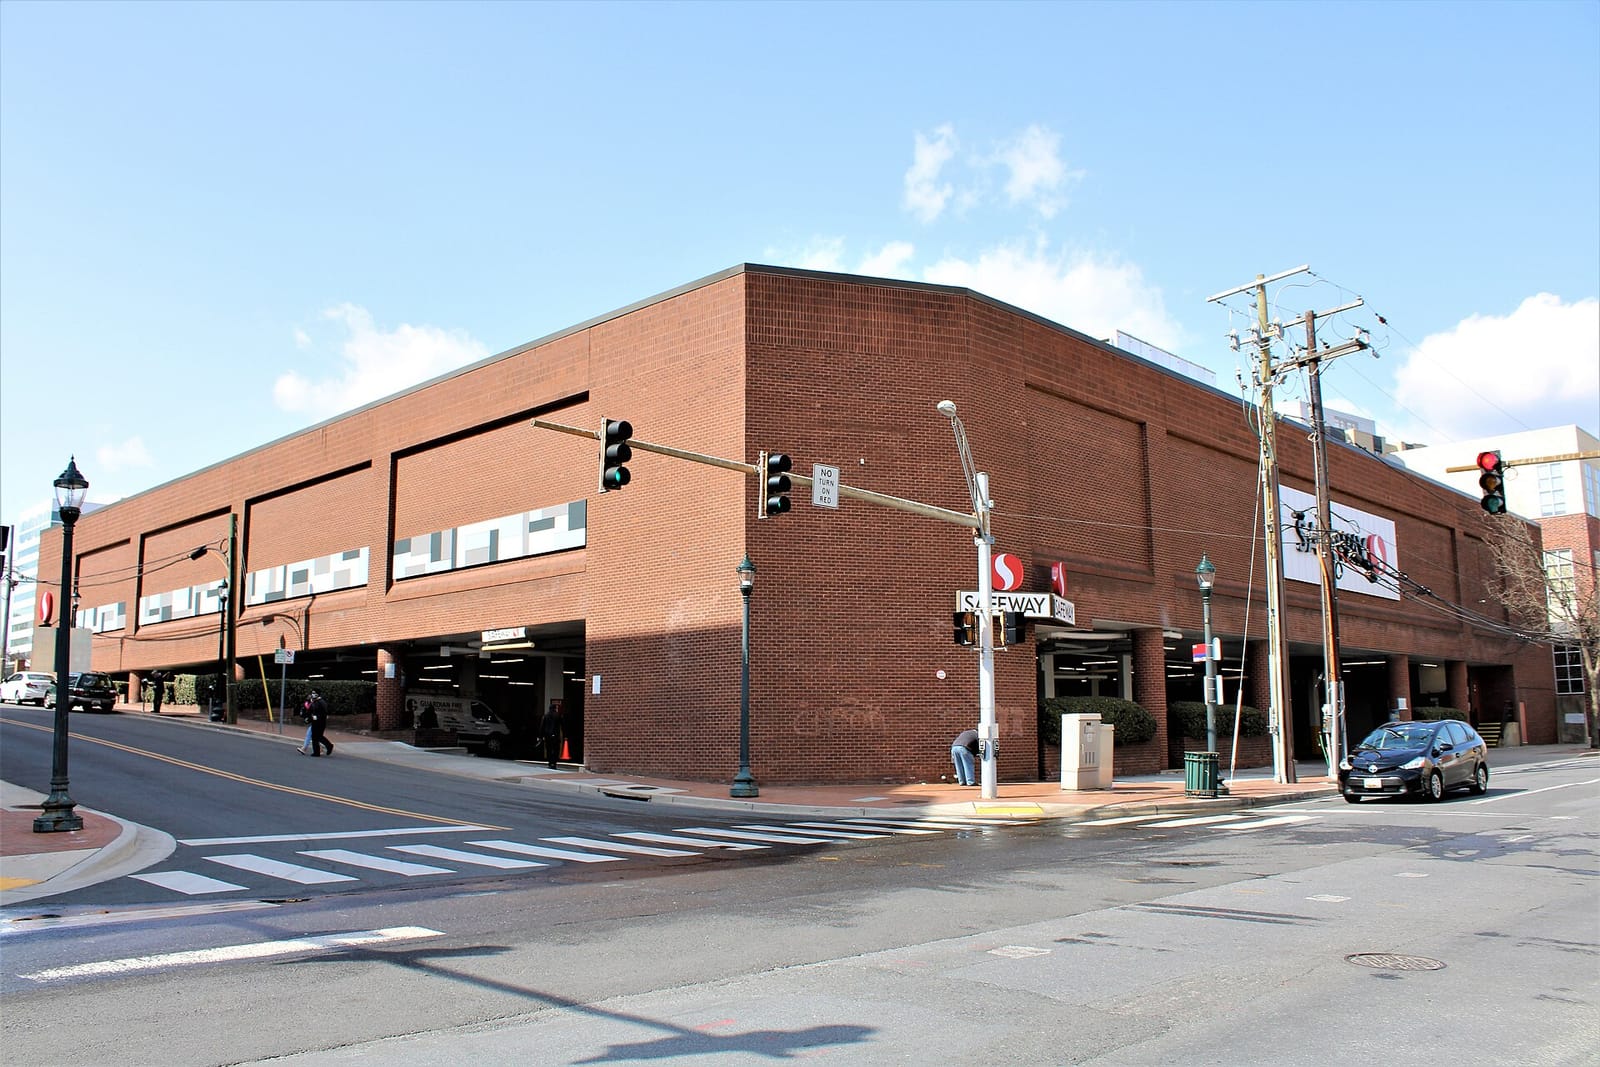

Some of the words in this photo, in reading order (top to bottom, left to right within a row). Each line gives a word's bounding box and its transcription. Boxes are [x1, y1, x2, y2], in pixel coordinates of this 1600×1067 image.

[821, 469, 832, 477] NO
[820, 478, 834, 486] TURN
[821, 487, 830, 495] ON
